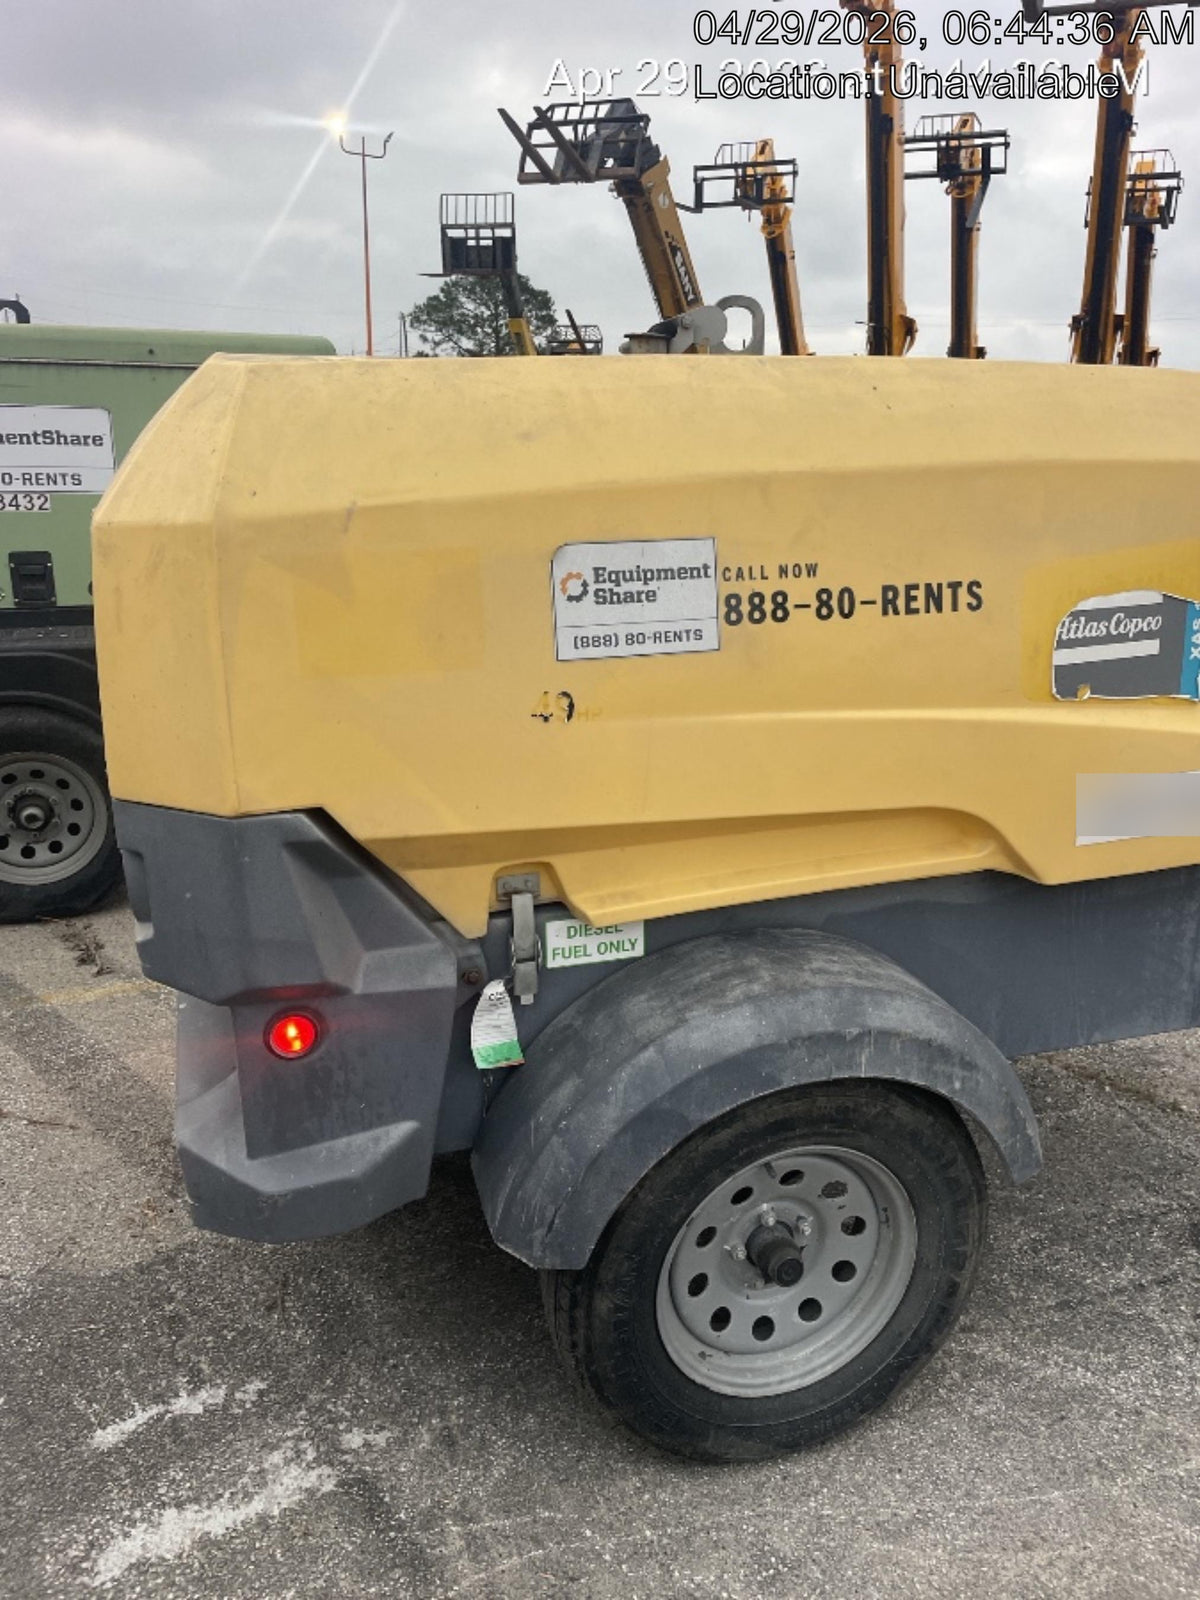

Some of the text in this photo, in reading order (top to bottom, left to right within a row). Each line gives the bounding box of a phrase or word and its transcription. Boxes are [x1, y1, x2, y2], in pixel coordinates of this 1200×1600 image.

[592, 563, 712, 588] Equipment
[722, 563, 818, 582] CALL NOW
[593, 586, 658, 606] Share
[1109, 612, 1162, 639] Copco
[625, 628, 704, 647] 80-RENTS
[552, 938, 638, 961] FUEL ONLY
